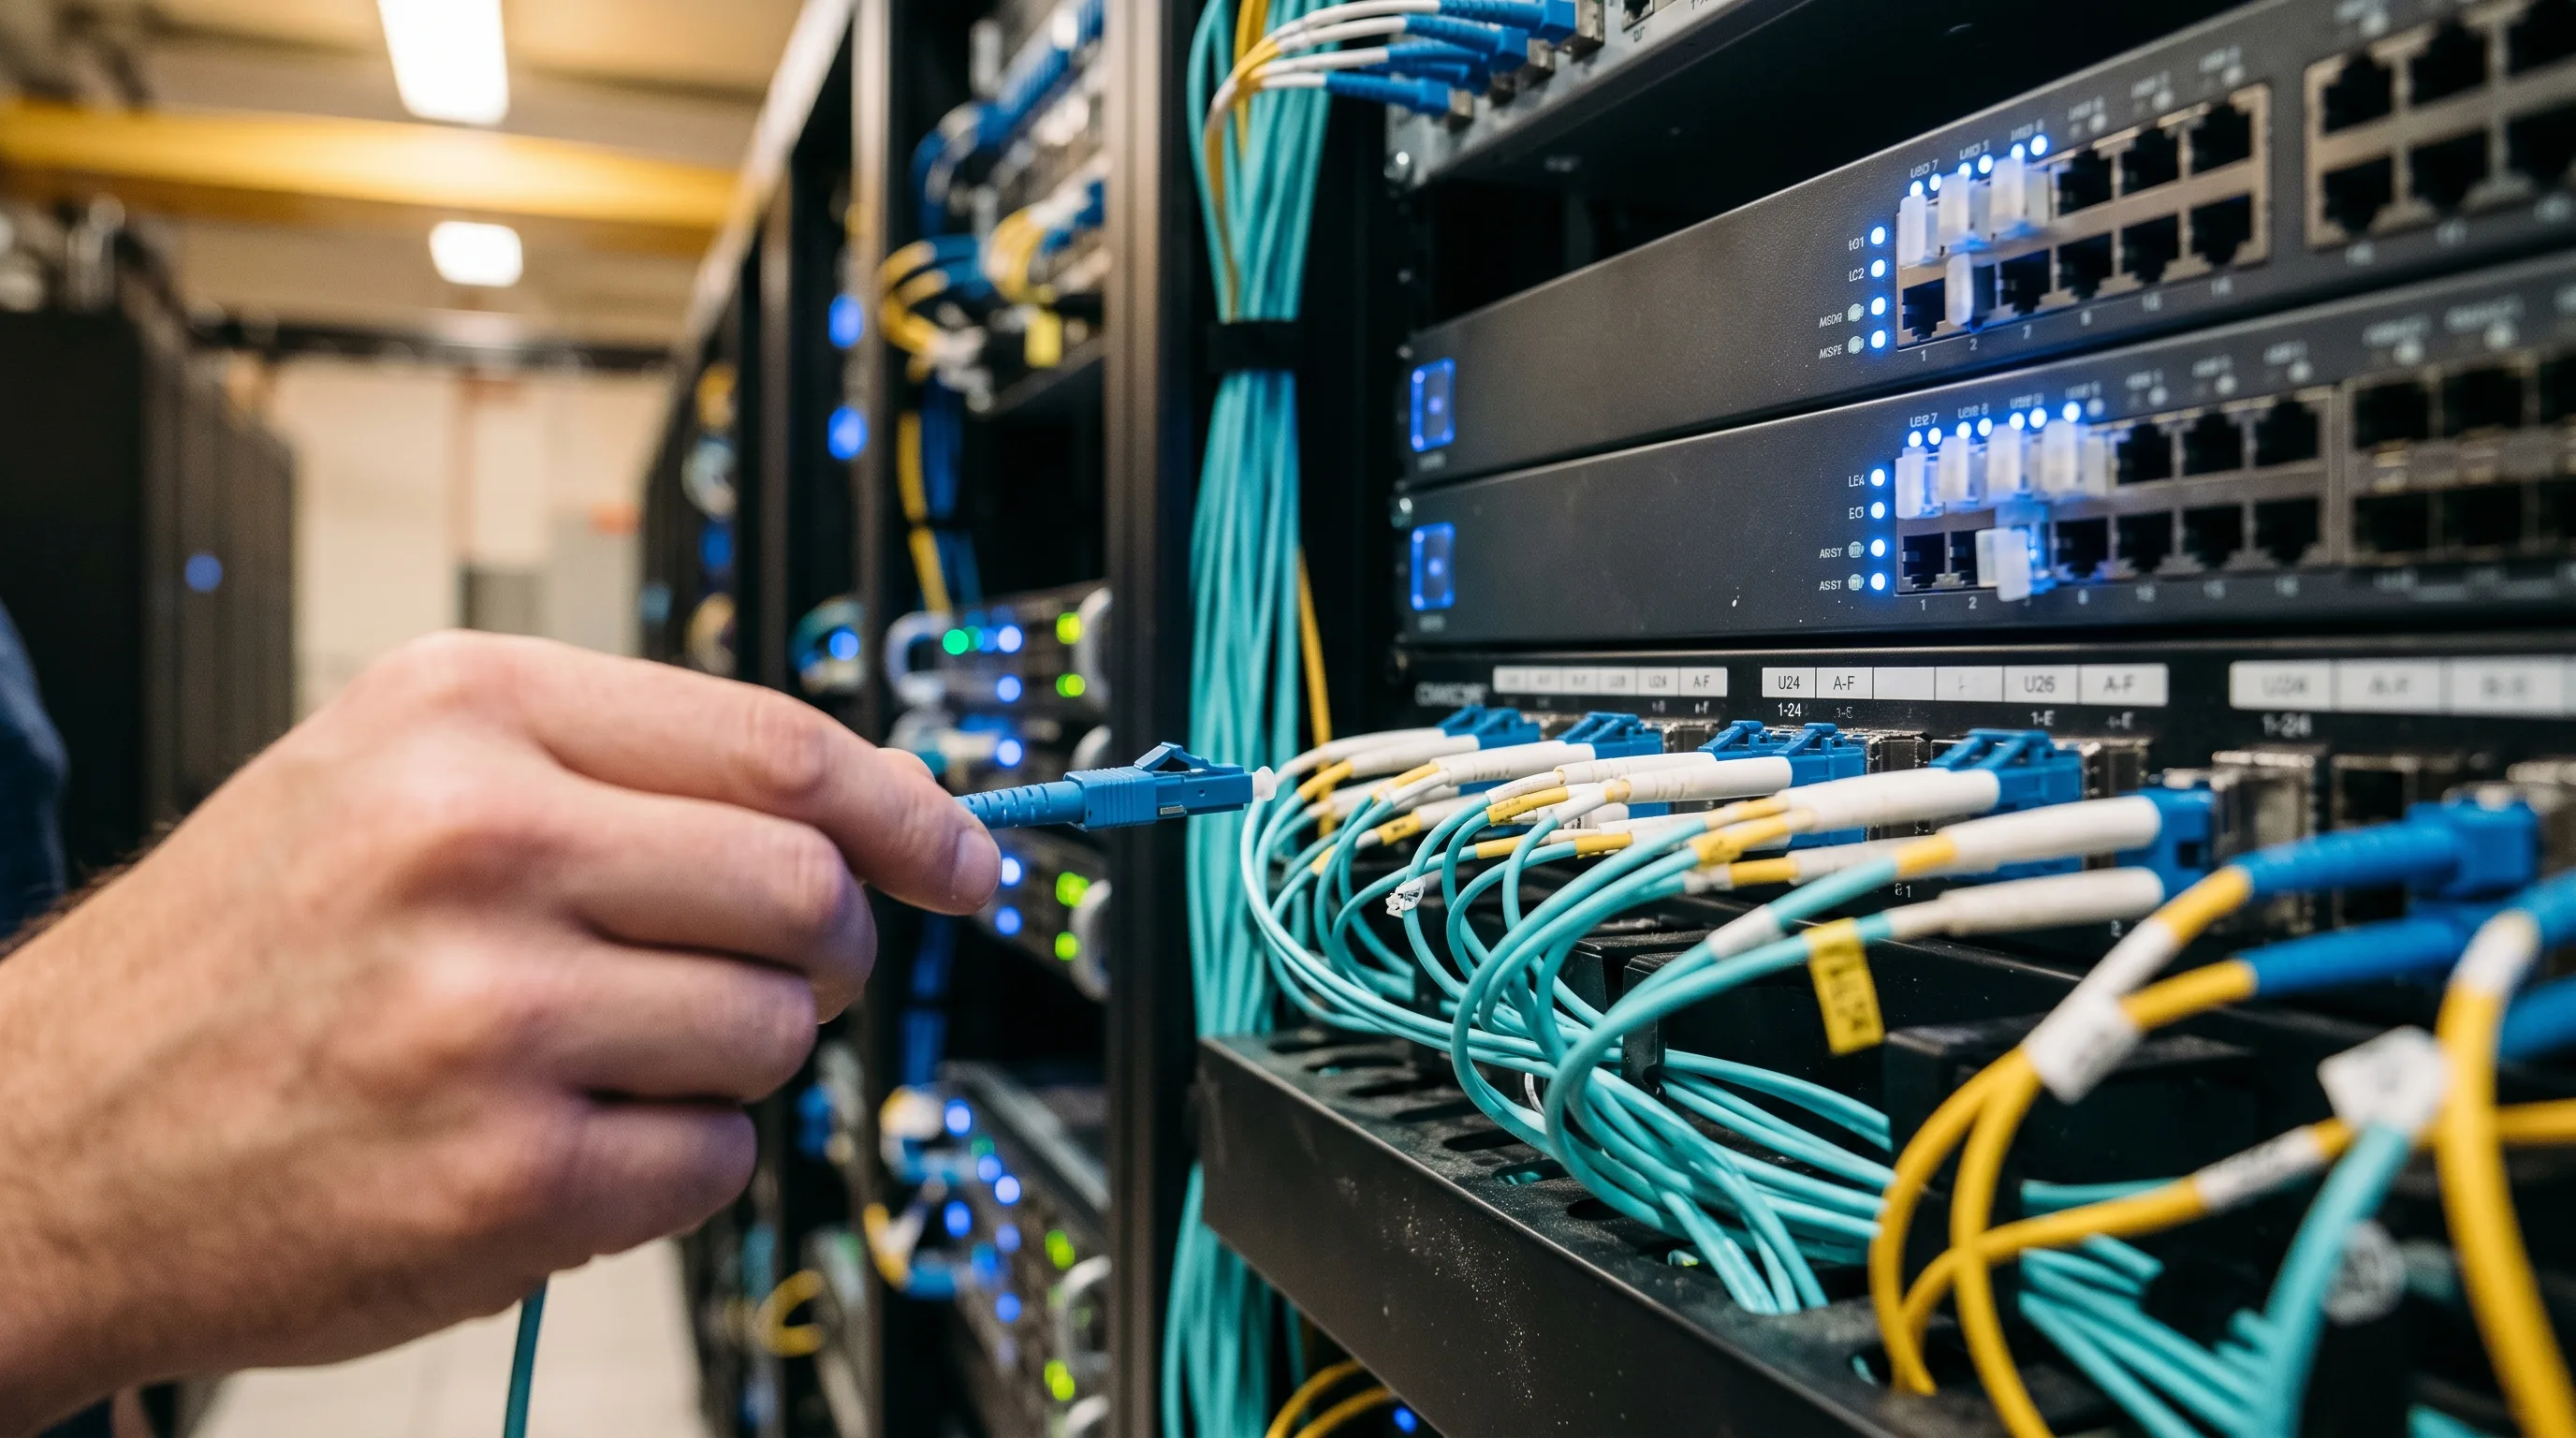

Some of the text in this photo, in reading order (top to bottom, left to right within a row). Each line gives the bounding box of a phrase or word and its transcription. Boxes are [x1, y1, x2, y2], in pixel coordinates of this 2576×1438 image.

[1921, 349, 1926, 362] 1
[1969, 338, 1978, 351] 2
[1920, 599, 1926, 611] 1
[1969, 595, 1978, 609] 2
[1778, 675, 1855, 691] U24 A-F
[2024, 675, 2056, 694] U26
[1778, 702, 1802, 717] 1-24
